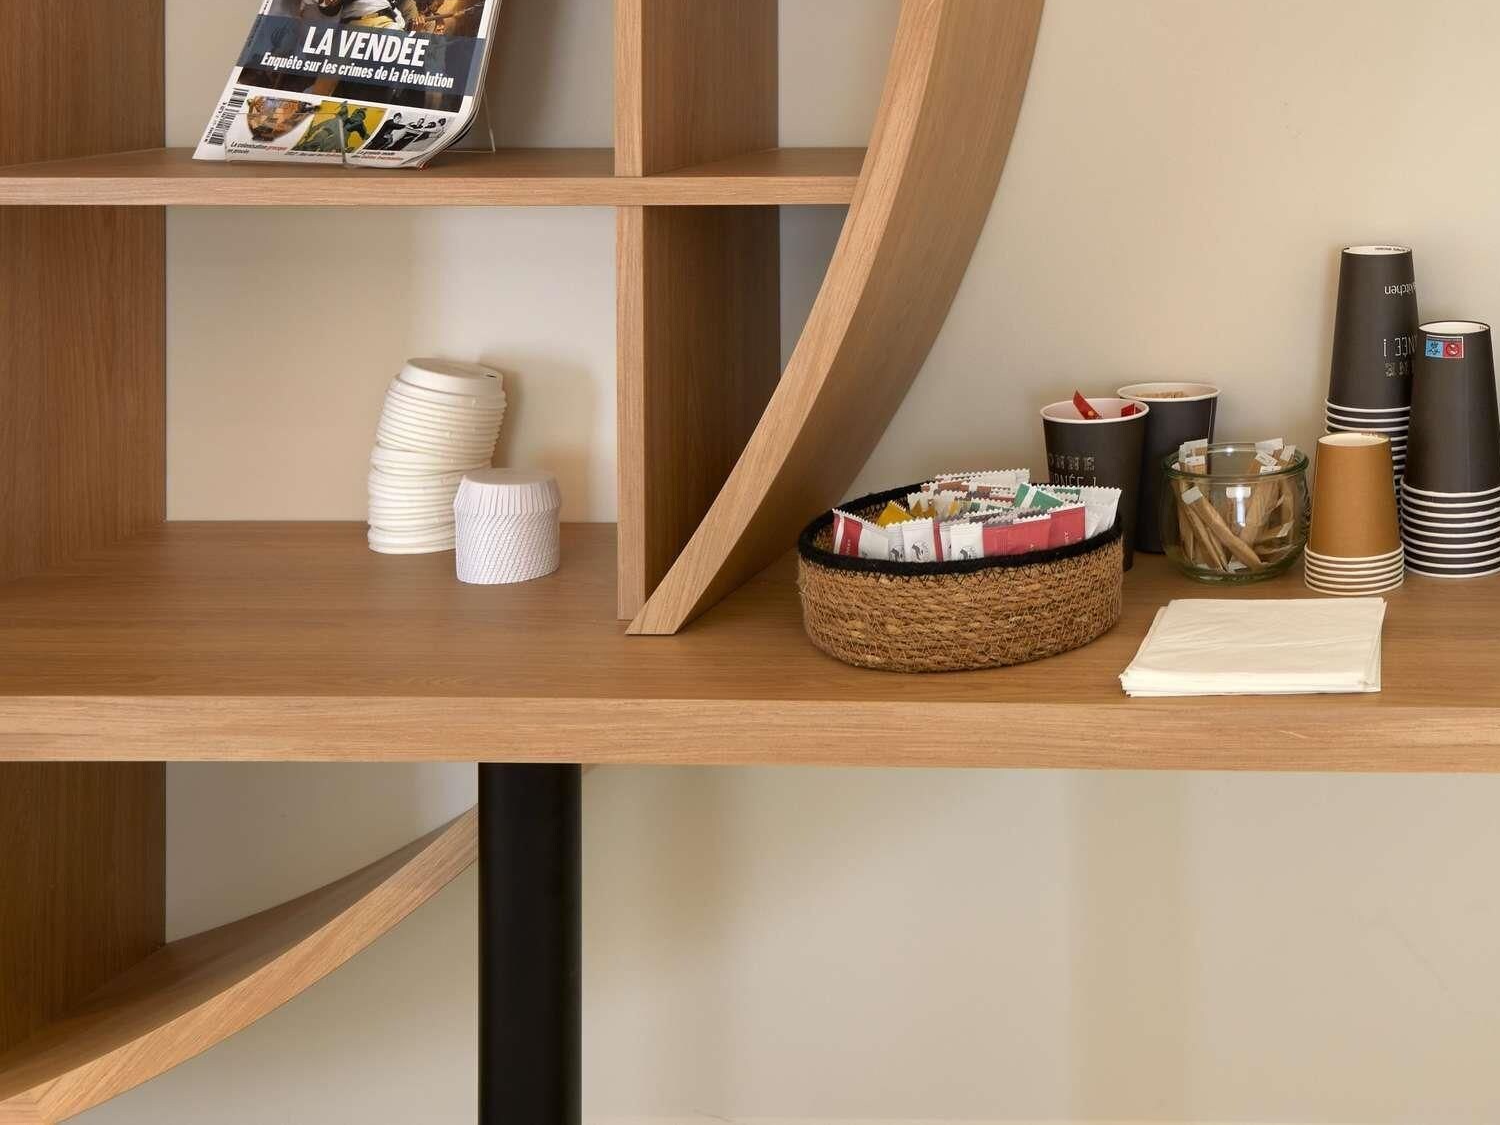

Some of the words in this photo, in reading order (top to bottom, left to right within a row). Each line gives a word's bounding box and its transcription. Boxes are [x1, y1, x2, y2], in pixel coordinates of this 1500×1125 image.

[302, 26, 334, 56] LA
[338, 30, 429, 67] VENDÉE
[260, 51, 303, 72] Enquête
[304, 61, 320, 73] sur
[321, 59, 337, 74] les
[338, 63, 374, 80] crimes
[374, 65, 389, 81] de
[389, 66, 400, 83] la
[400, 68, 454, 89] Révolution
